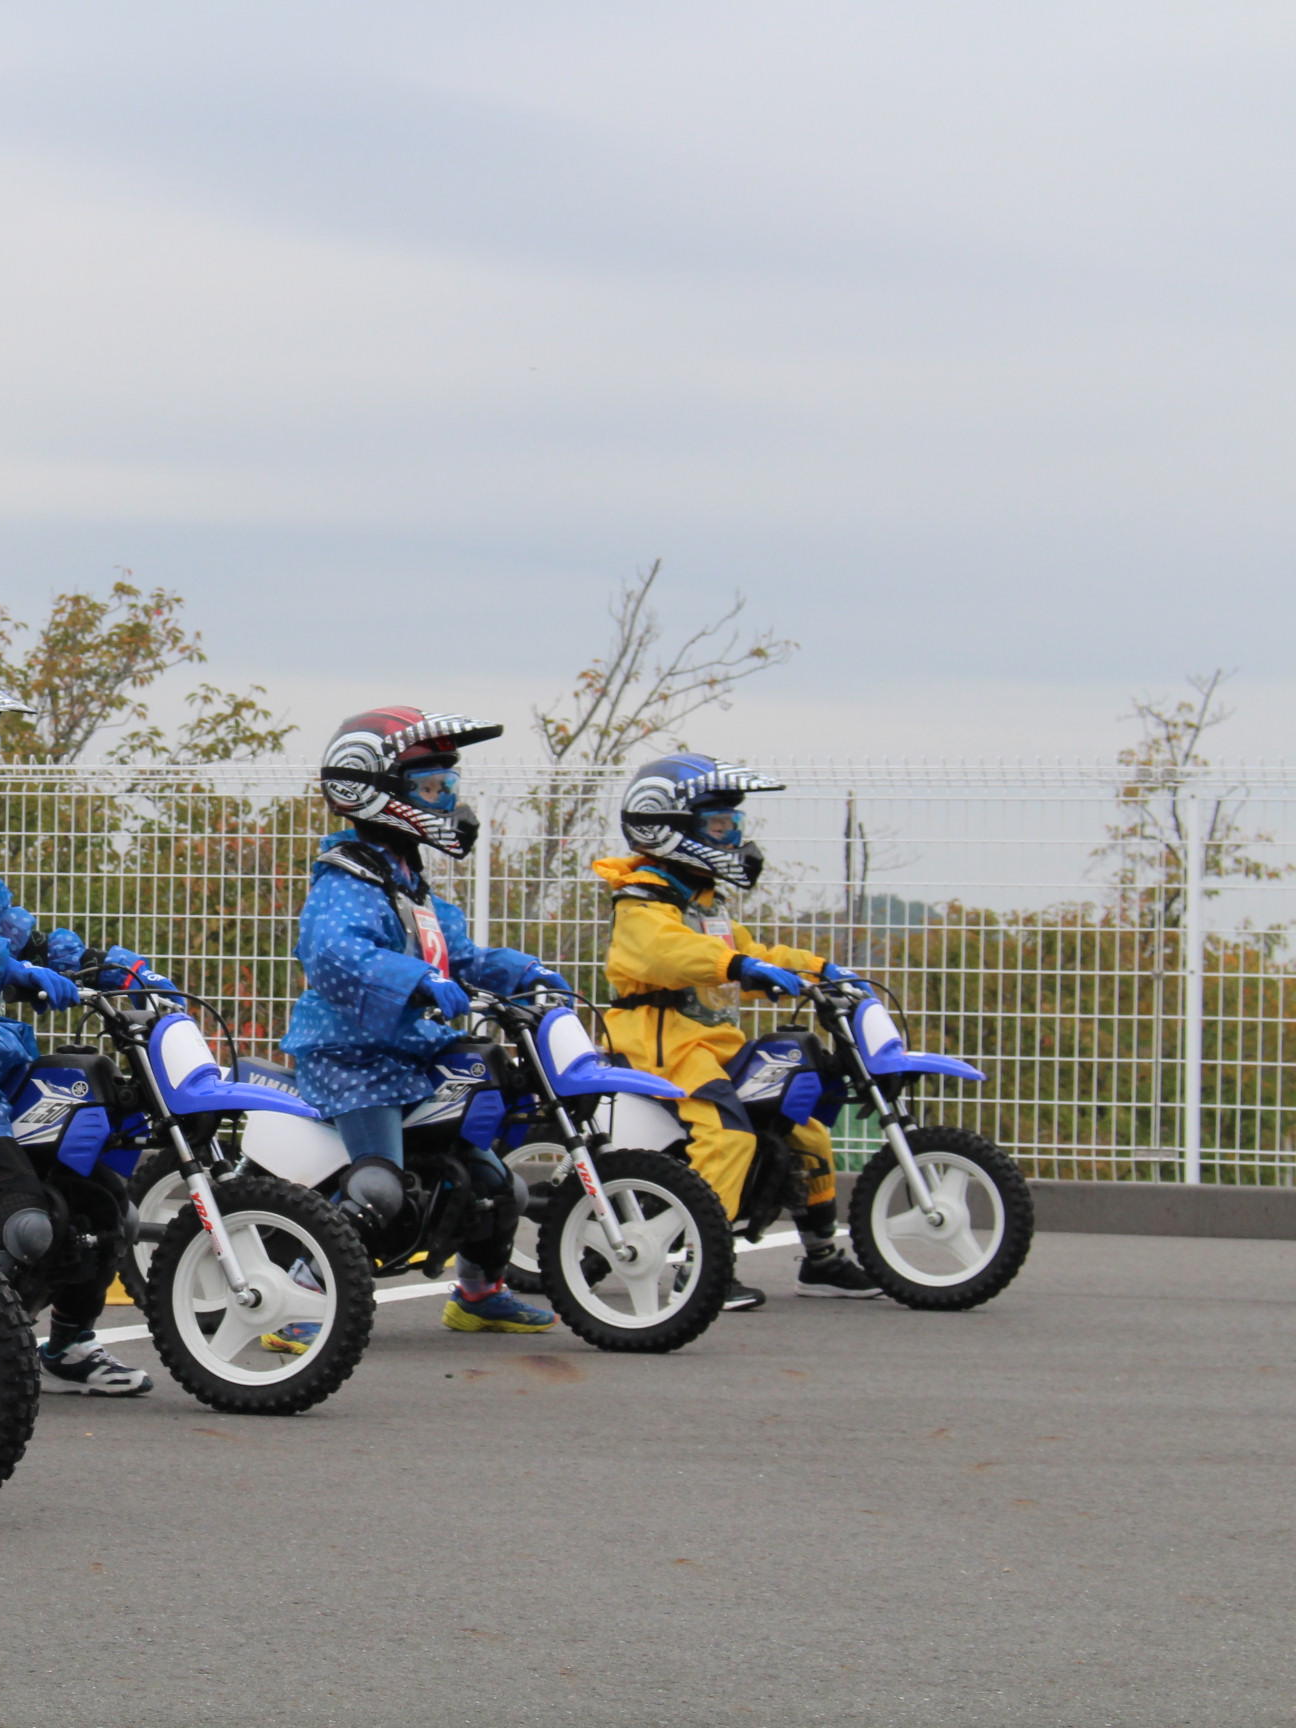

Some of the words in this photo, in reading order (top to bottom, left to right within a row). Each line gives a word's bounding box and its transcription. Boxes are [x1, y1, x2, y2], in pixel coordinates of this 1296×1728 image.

[248, 1072, 301, 1098] YAMAH
[575, 1162, 598, 1196] YRA
[190, 1191, 214, 1232] YRA
